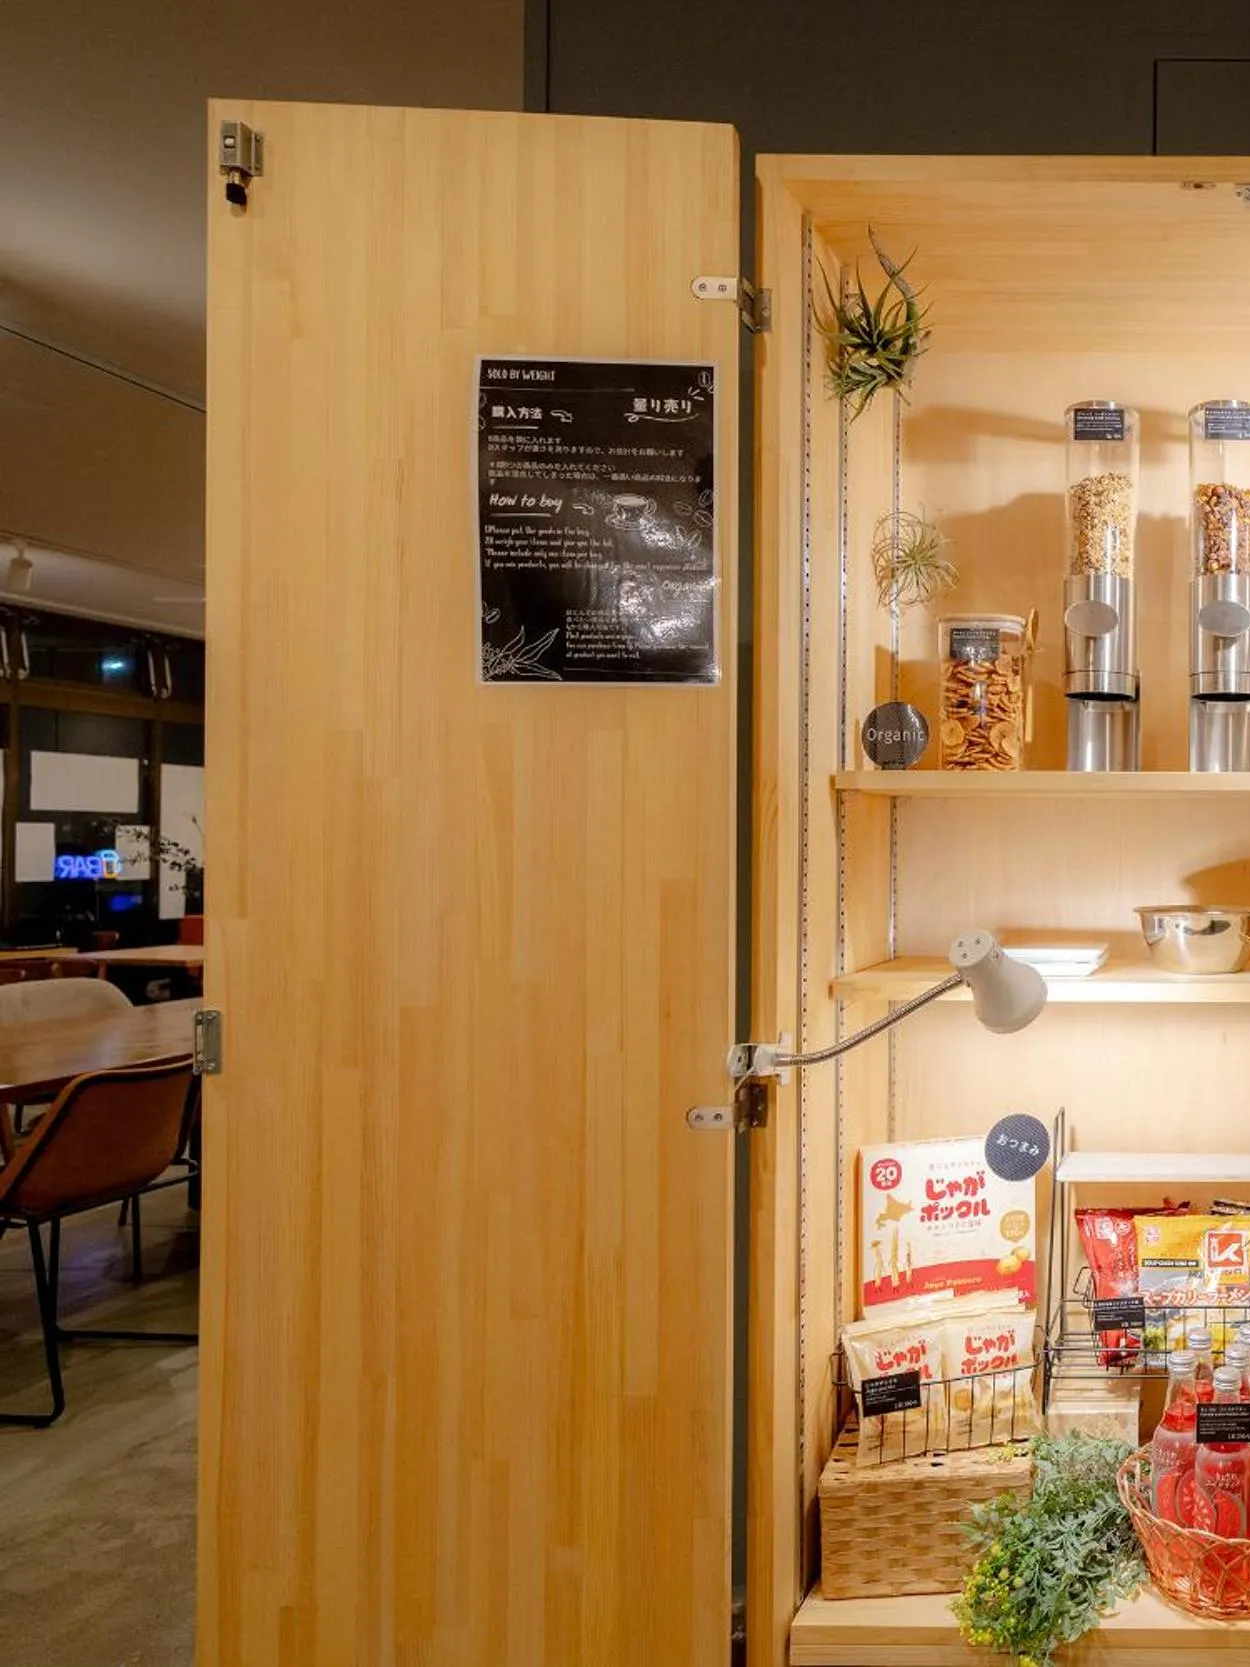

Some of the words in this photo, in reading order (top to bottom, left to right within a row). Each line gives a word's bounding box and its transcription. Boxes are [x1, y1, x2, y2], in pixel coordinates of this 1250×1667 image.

[487, 369, 507, 380] SOLD
[509, 369, 520, 380] BY
[521, 369, 556, 381] WEIGHT
[491, 406, 543, 420] 購入方法
[632, 398, 692, 414] 量り売り
[489, 494, 517, 506] How
[521, 494, 536, 506] to
[539, 494, 562, 513] buy
[866, 728, 925, 744] Organic
[996, 1132, 1040, 1157] おつまみ
[875, 1167, 898, 1182] 20
[925, 1169, 986, 1201] じゃが
[920, 1198, 991, 1223] ポックル
[964, 1329, 1017, 1355] じゃが
[874, 1339, 930, 1371] じゃが
[960, 1353, 1019, 1376] ポックル
